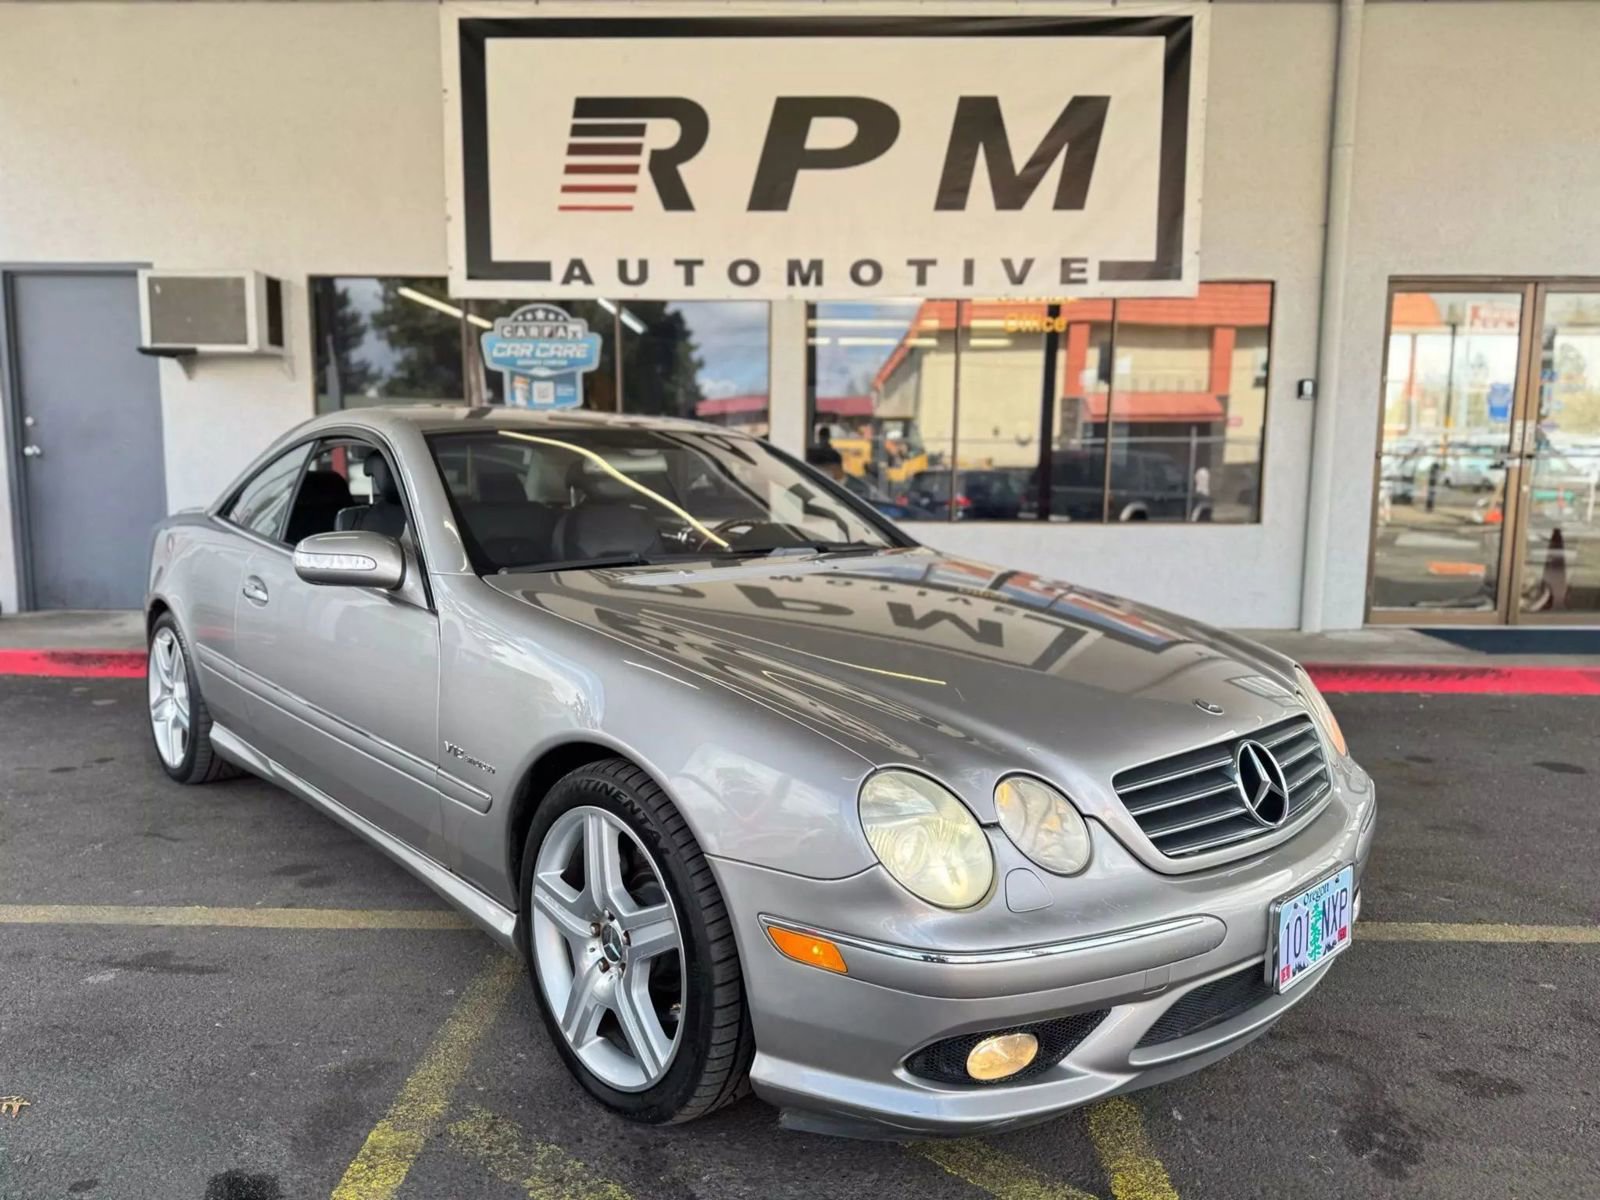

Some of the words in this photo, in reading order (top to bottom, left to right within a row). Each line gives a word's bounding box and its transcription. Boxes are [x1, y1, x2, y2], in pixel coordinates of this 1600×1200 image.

[558, 96, 1111, 212] RPM
[560, 257, 1090, 287] AUTOMOTIVE
[492, 343, 533, 358] CAR
[534, 343, 591, 358] CARE
[1303, 883, 1329, 906] Oregon
[1285, 909, 1310, 965] 101
[1321, 887, 1348, 941] NXP
